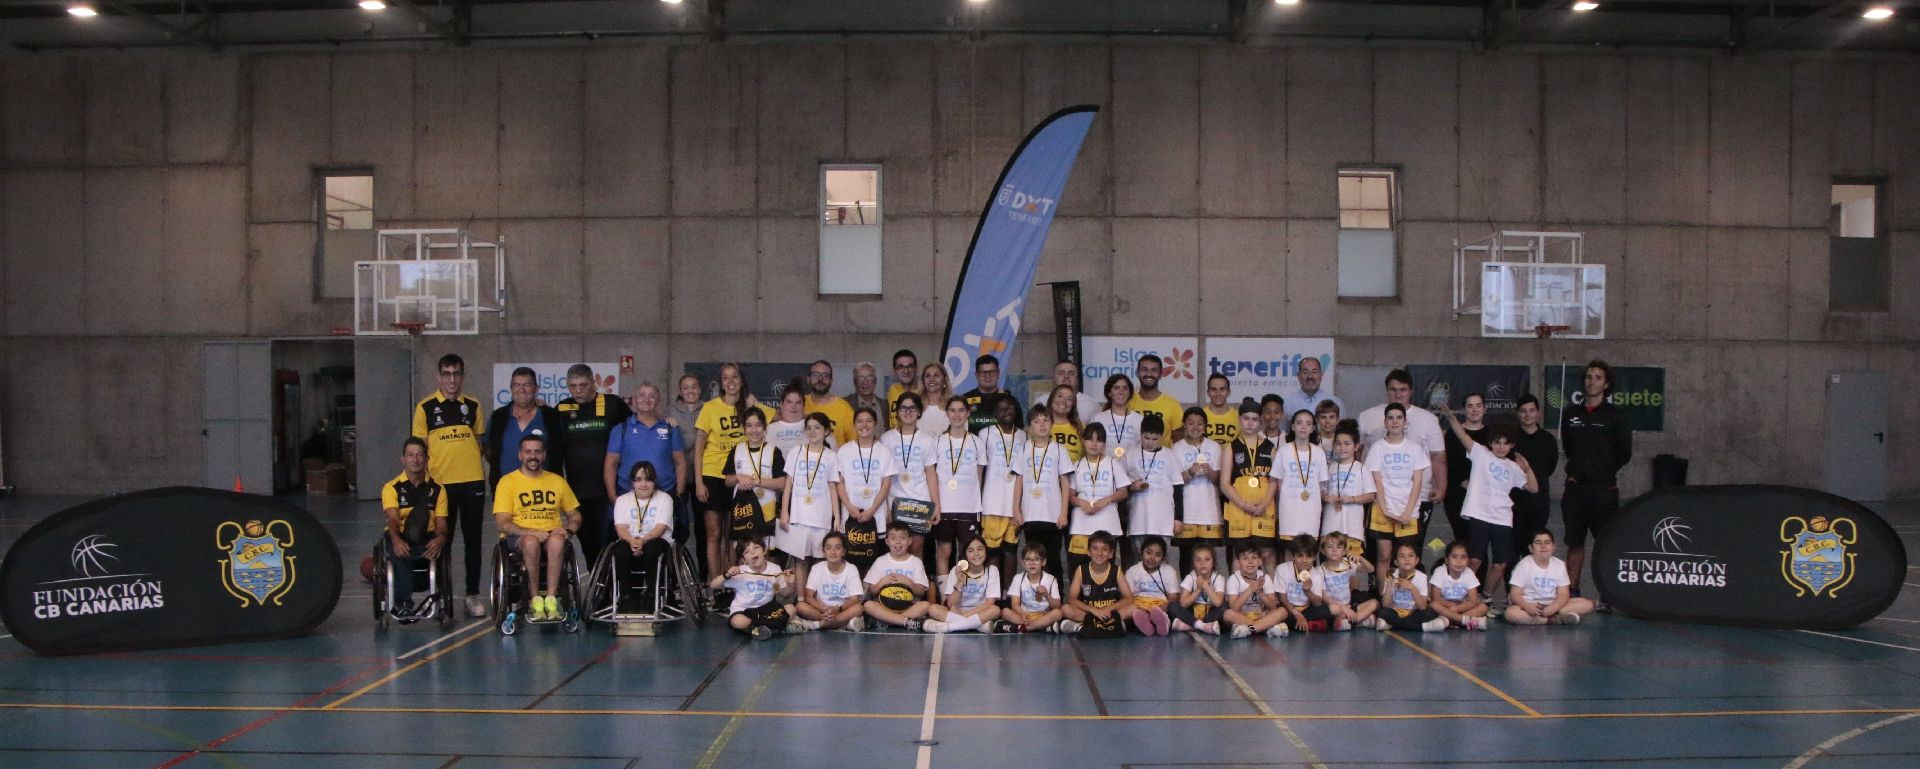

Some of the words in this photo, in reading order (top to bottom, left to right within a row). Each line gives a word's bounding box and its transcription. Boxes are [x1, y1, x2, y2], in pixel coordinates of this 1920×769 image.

[1012, 192, 1054, 215] DXT
[1209, 354, 1302, 377] tenerif
[720, 416, 740, 430] CB
[1204, 423, 1237, 437] CBC
[1055, 432, 1078, 446] BC
[1384, 453, 1411, 464] CBC
[519, 490, 556, 507] CBC
[1618, 558, 1727, 576] FUNDACIÓN
[1617, 571, 1639, 583] CB
[1643, 572, 1727, 588] CANARIAS
[33, 578, 163, 606] FUNDACIÓN
[822, 583, 847, 596] CBC
[34, 601, 60, 619] CB
[65, 595, 164, 617] CANARIAS
